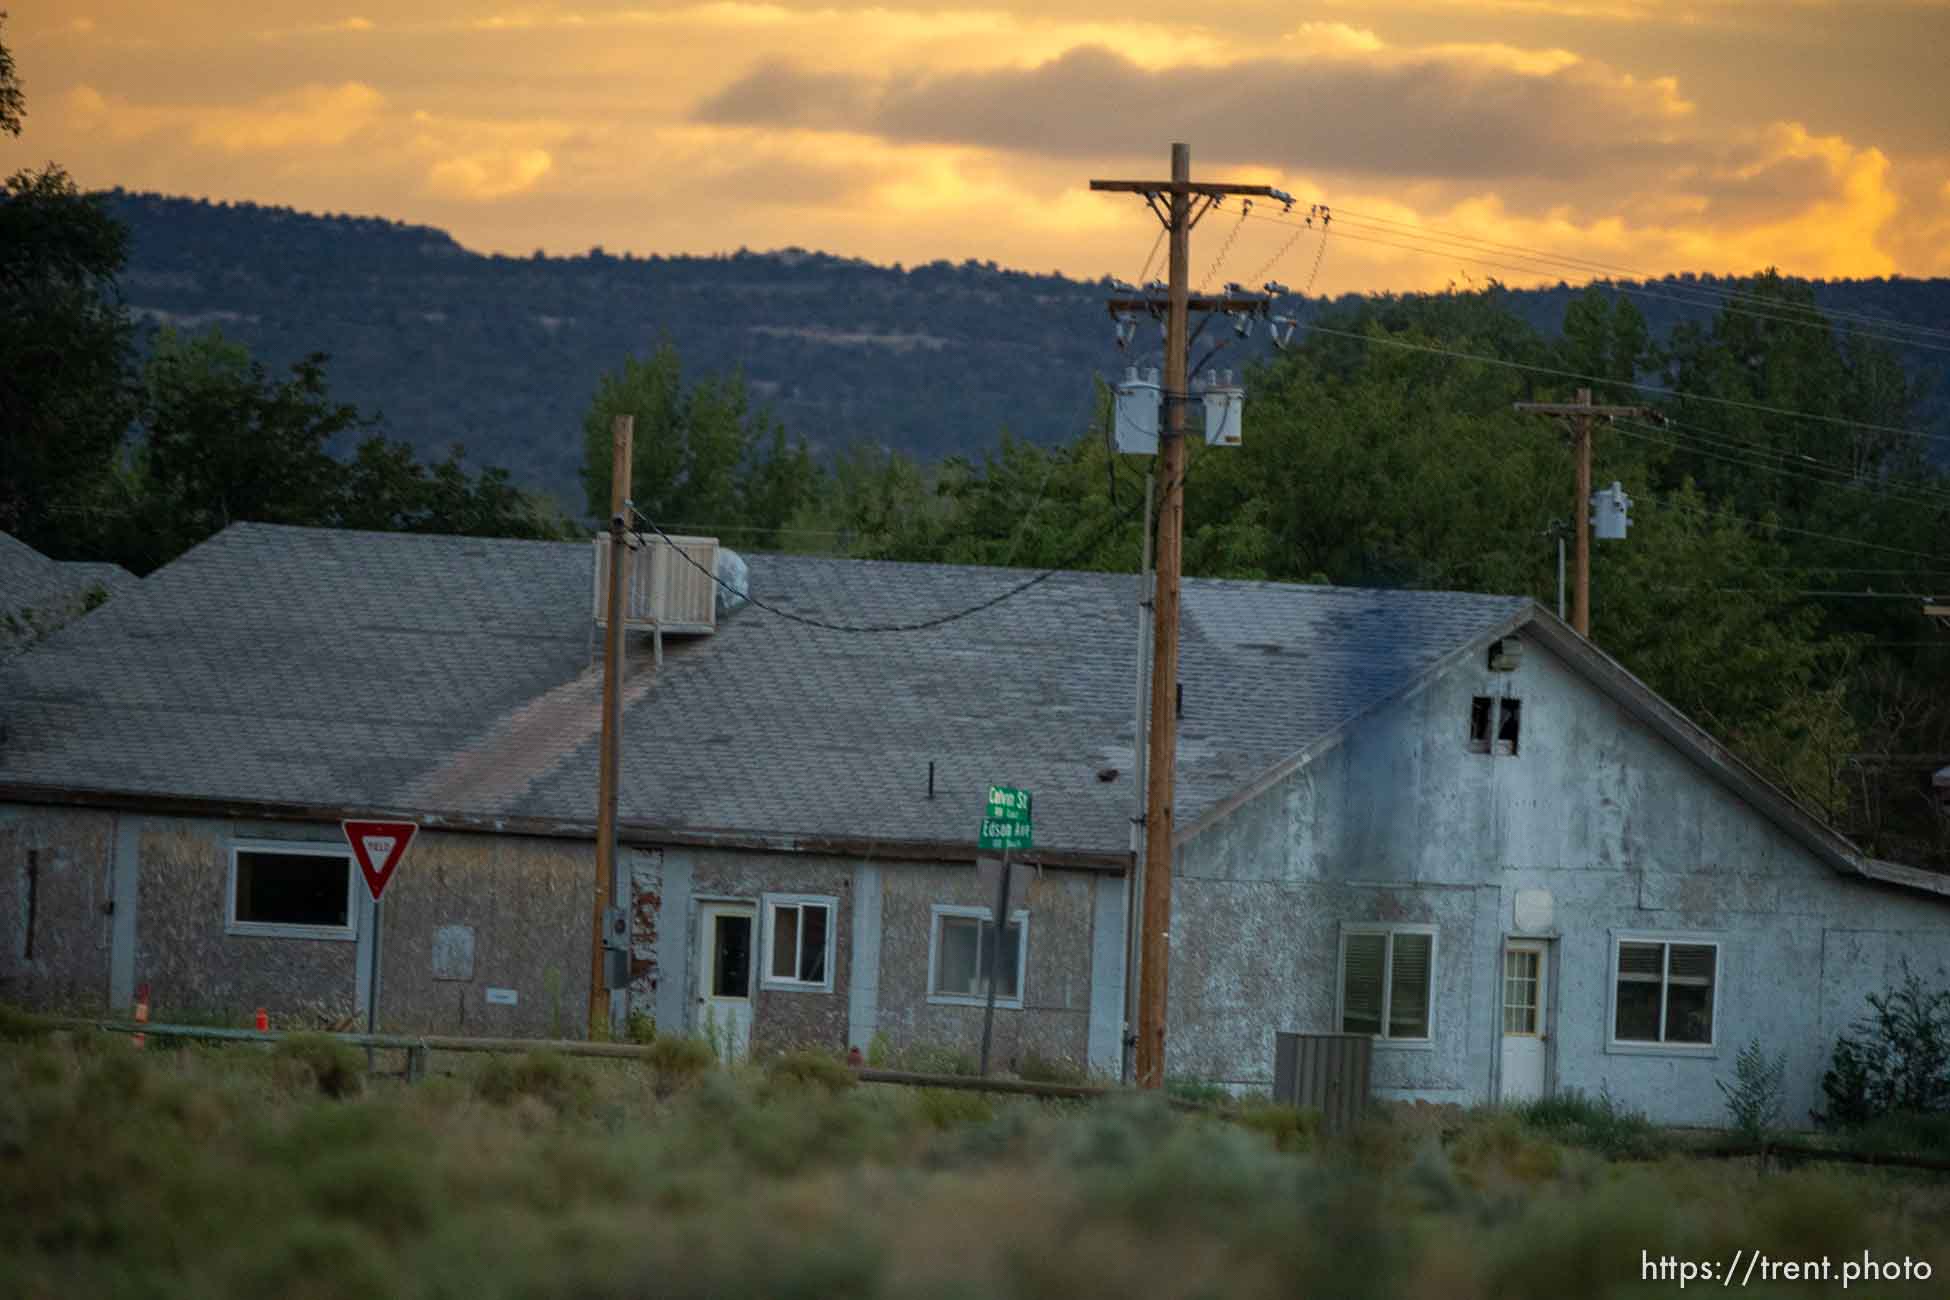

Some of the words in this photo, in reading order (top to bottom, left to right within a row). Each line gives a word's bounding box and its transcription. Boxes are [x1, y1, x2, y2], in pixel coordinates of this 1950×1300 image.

[1016, 791, 1028, 809] St
[983, 820, 1012, 838] Edson
[1014, 821, 1030, 838] Ave
[367, 841, 390, 852] YIELD
